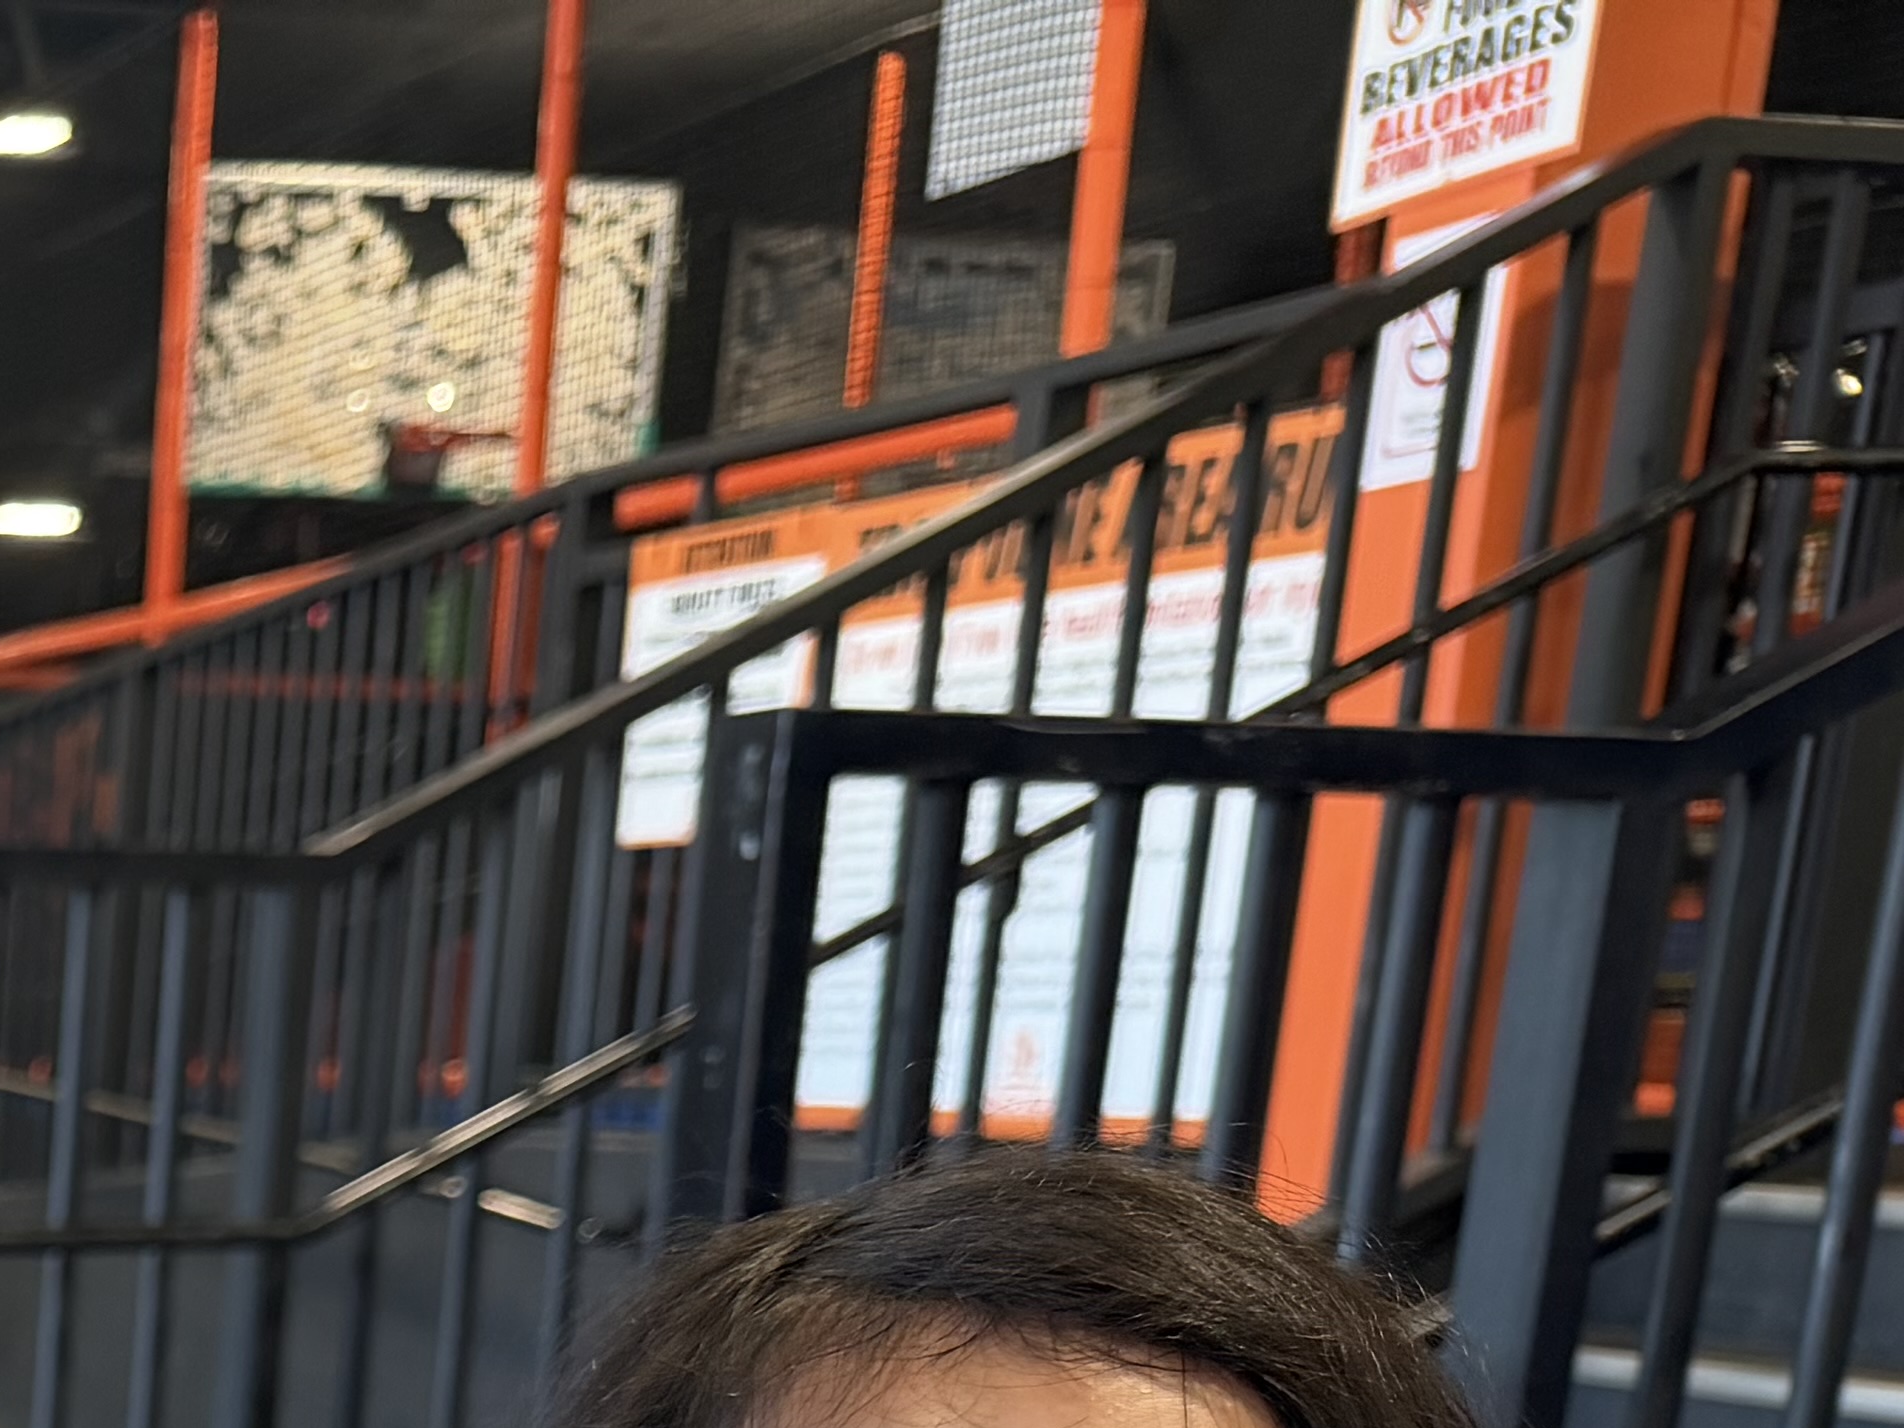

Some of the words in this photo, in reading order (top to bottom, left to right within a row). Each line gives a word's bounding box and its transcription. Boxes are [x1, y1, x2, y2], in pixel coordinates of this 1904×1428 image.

[1360, 2, 1574, 115] BEVERAGES
[1372, 58, 1549, 149] ALLOWED
[1441, 120, 1481, 160] THIS
[1490, 99, 1551, 148] POINT
